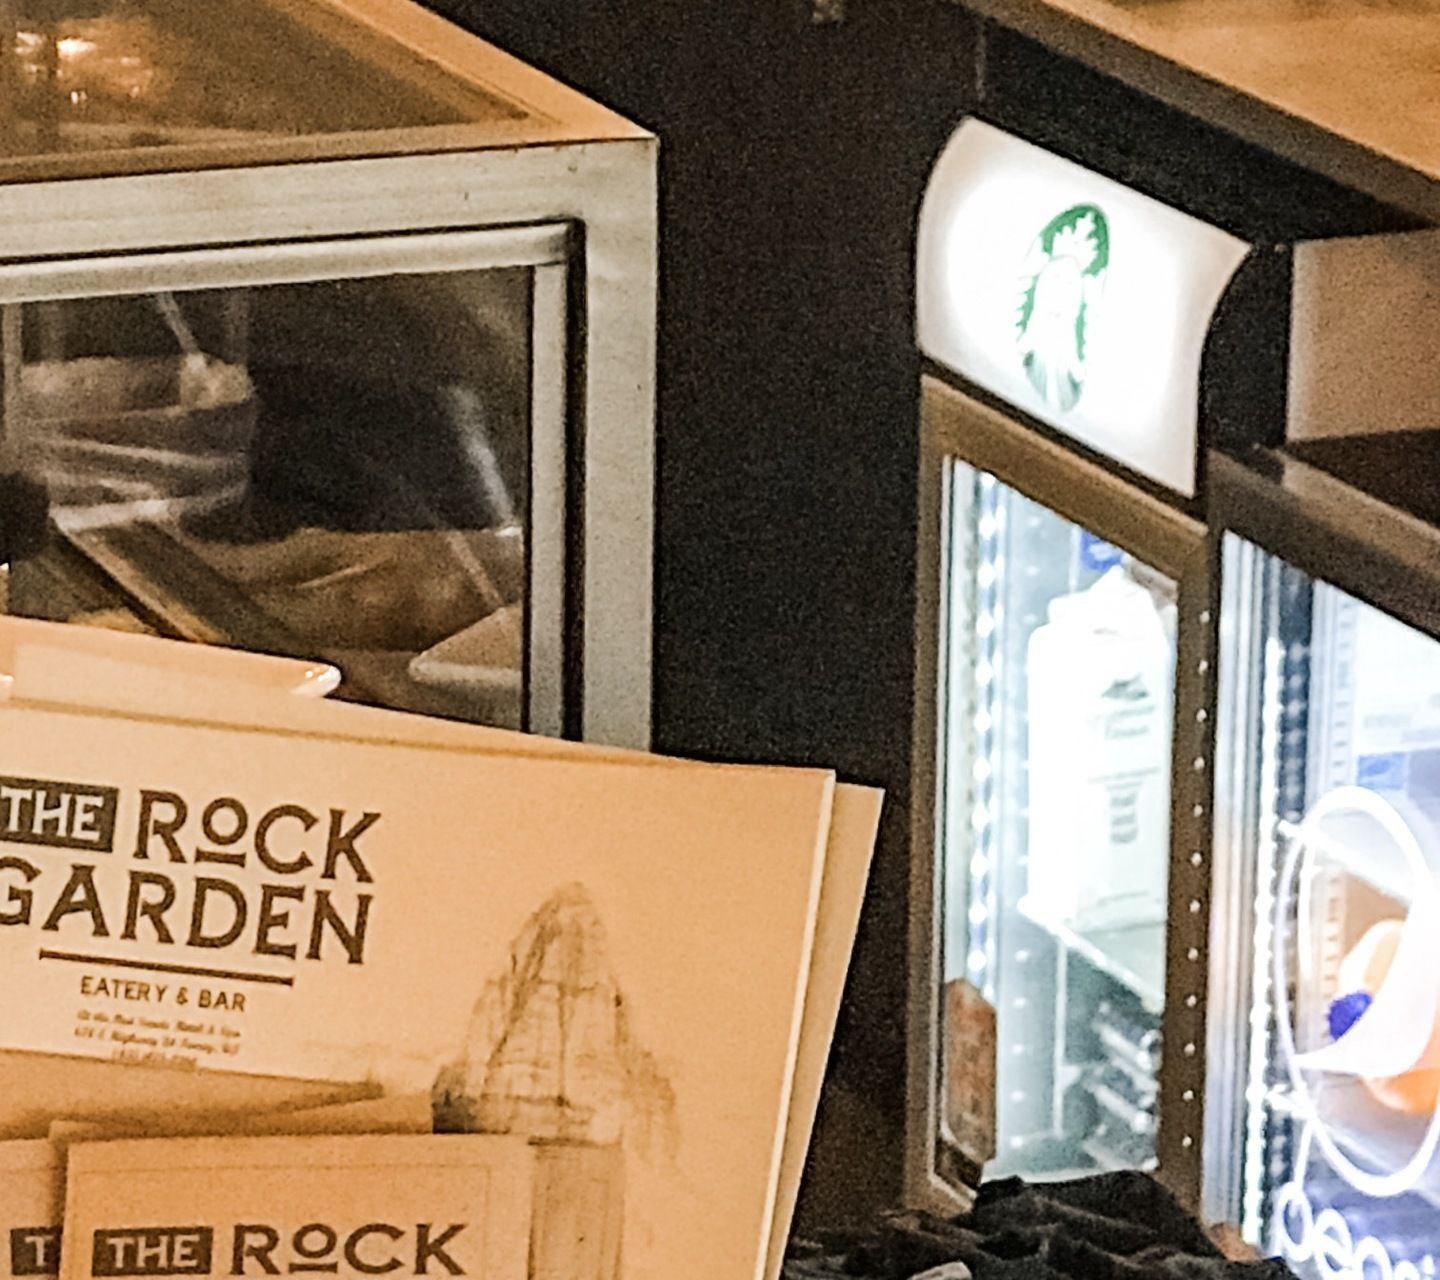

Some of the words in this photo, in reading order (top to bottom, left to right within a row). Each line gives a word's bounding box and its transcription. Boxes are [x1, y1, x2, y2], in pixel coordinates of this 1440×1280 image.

[132, 789, 383, 884] ROCK
[79, 975, 169, 1003] EATERY
[175, 986, 190, 1006] &
[197, 988, 247, 1013] BAR
[104, 1232, 201, 1270] THE
[230, 1223, 468, 1277] ROCK
